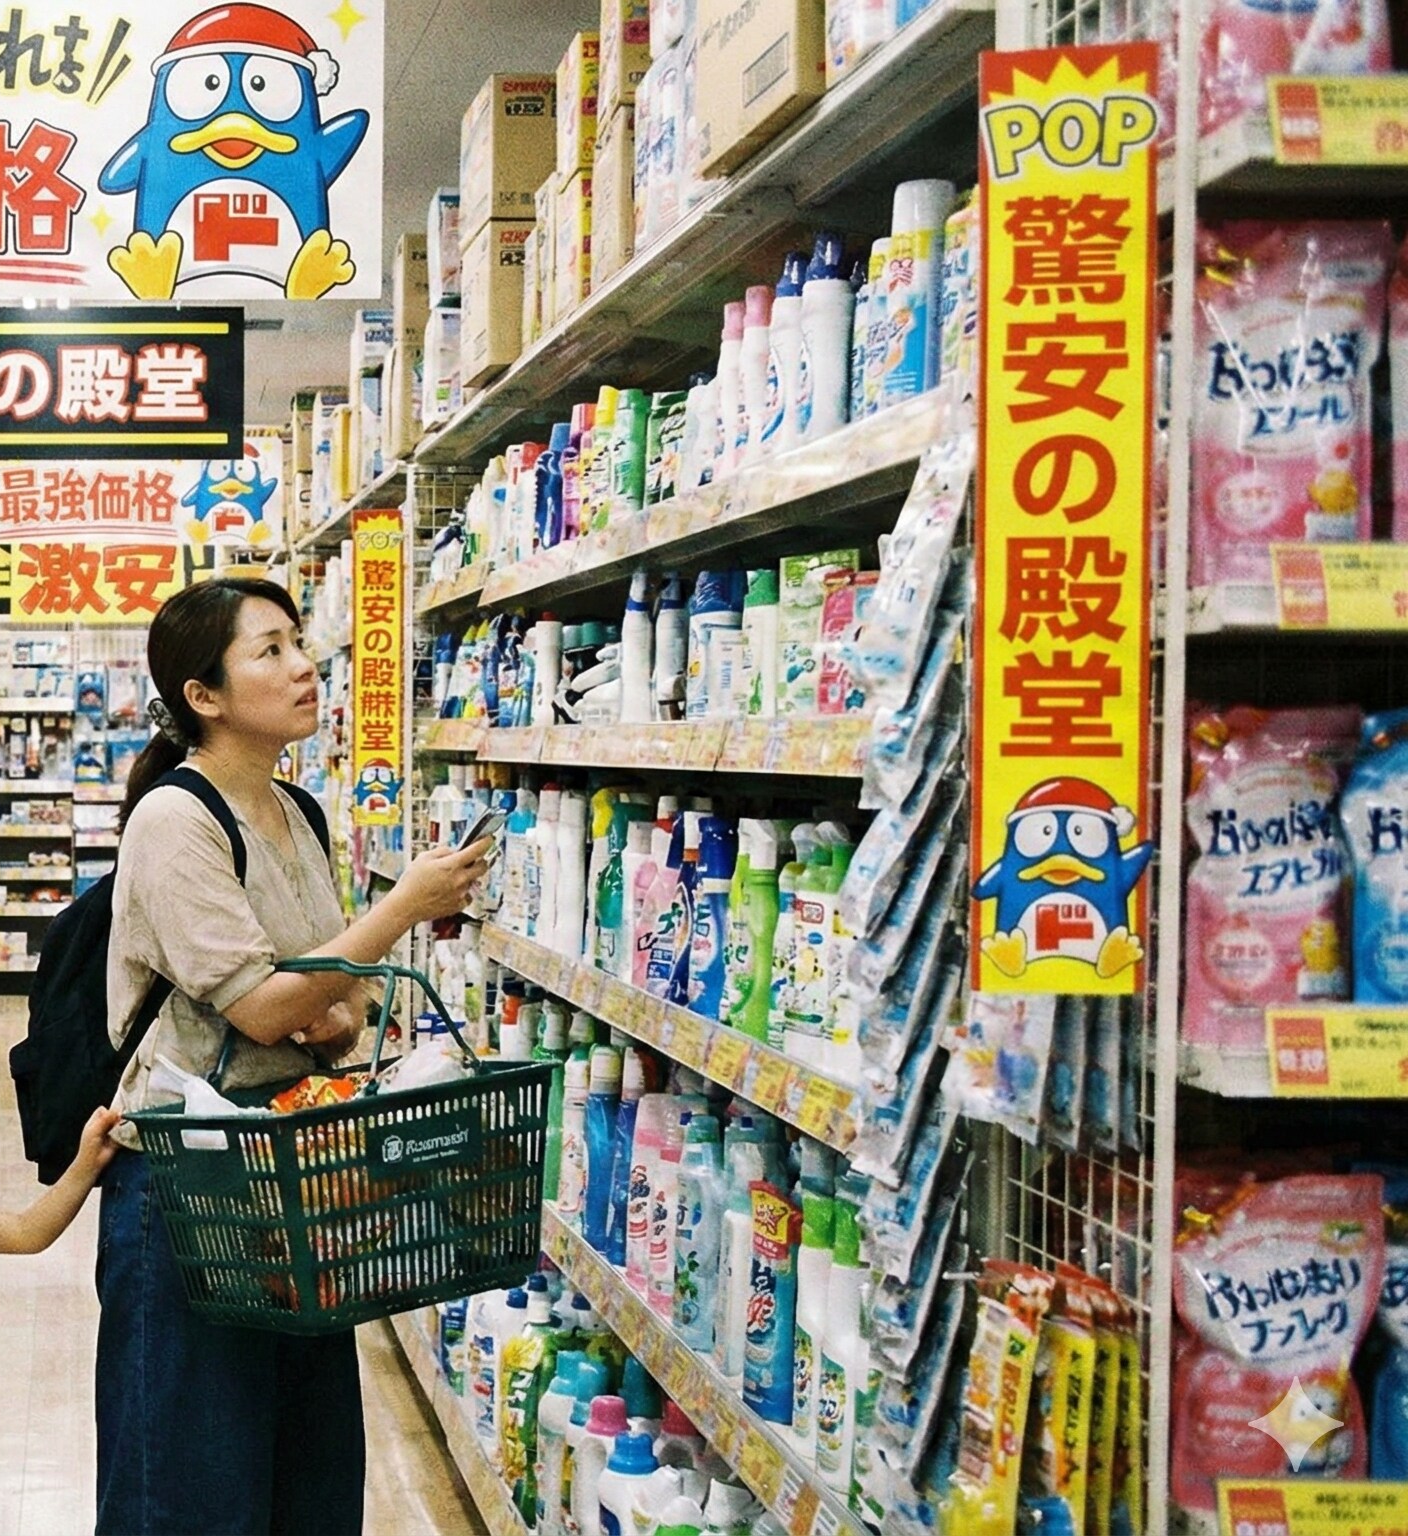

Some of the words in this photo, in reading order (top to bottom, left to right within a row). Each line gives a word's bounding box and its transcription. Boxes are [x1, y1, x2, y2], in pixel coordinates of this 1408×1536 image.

[985, 95, 1159, 180] POP
[998, 193, 1133, 757] 驚安の殿堂
[18, 542, 178, 615] 激安
